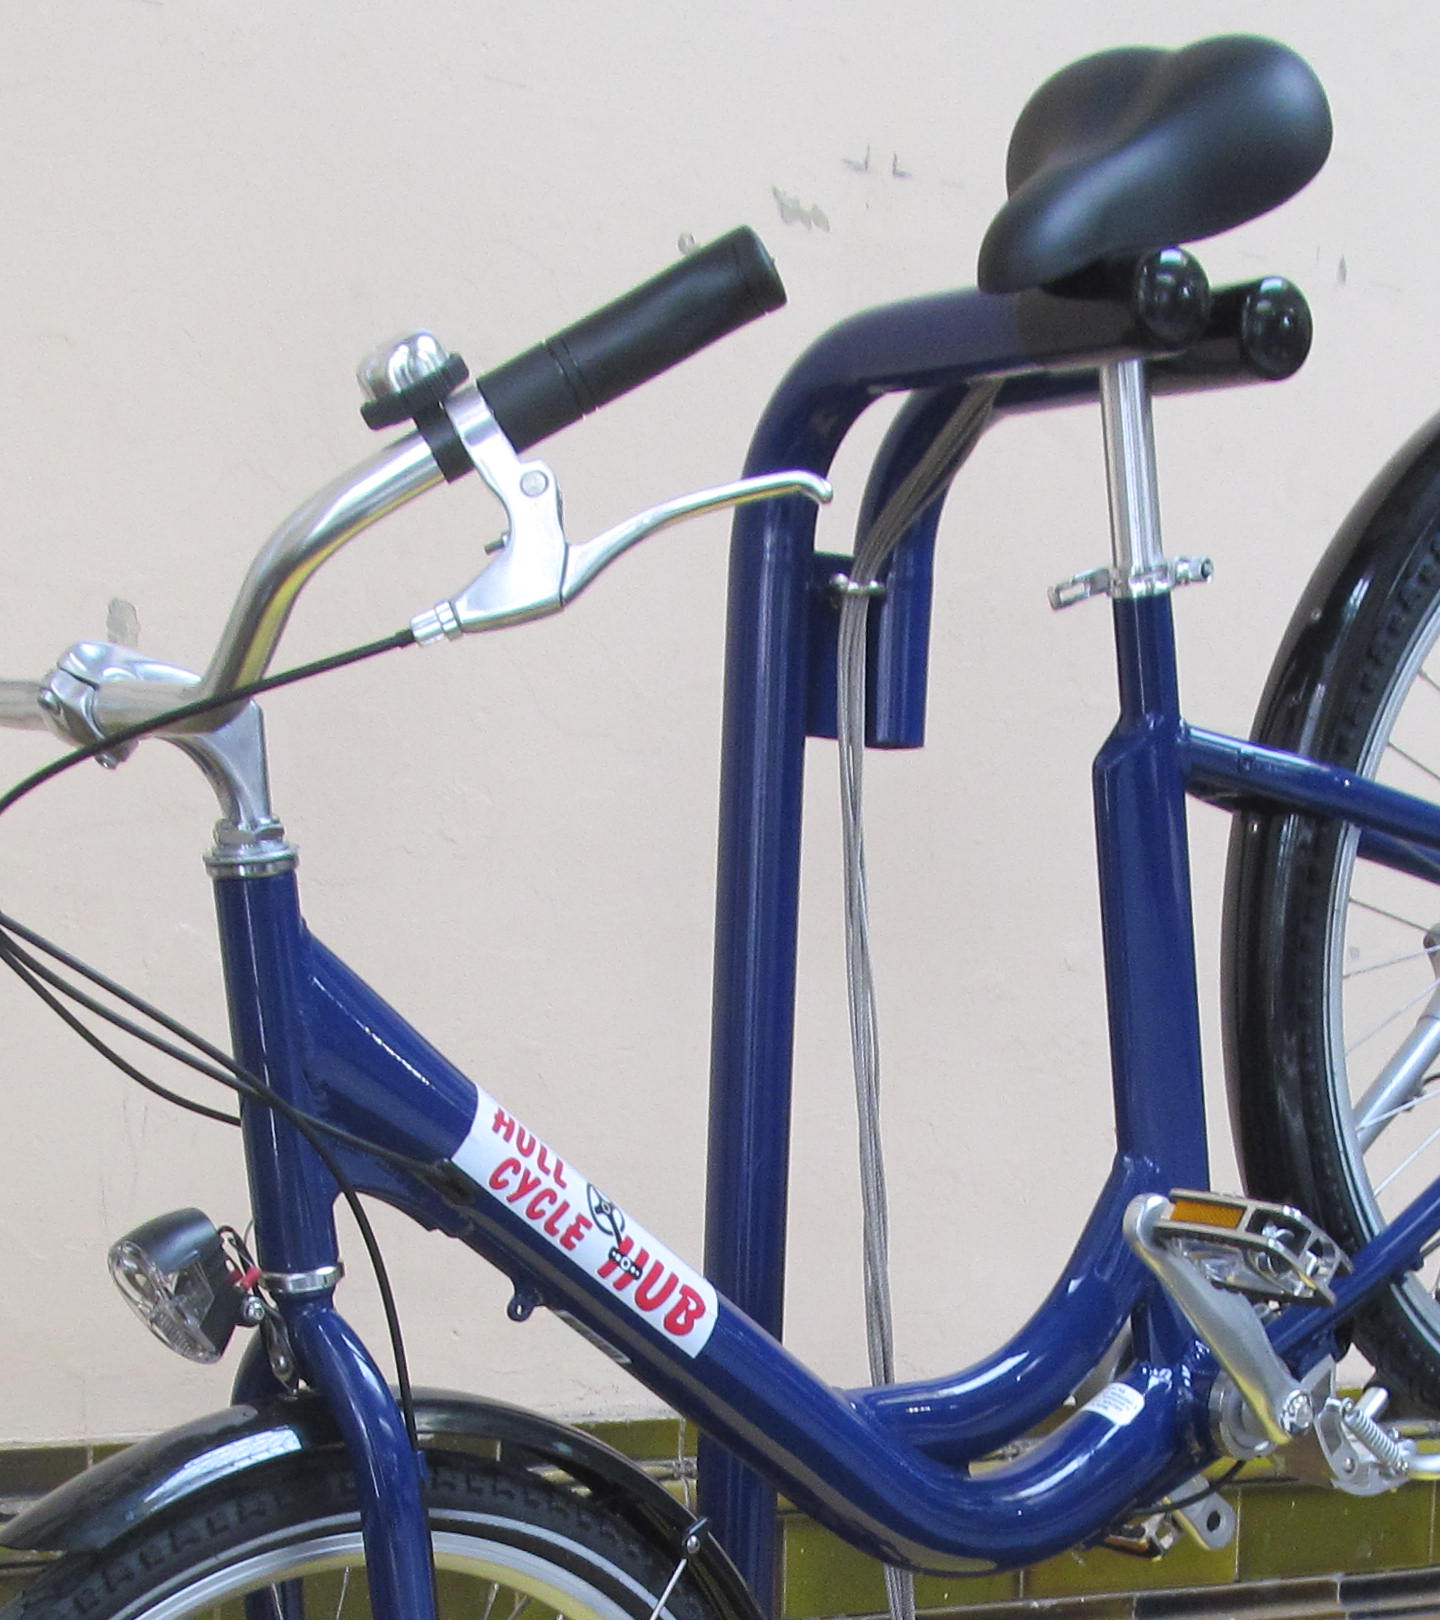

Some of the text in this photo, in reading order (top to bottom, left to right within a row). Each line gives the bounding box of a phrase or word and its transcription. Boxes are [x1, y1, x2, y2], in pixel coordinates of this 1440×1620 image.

[491, 1107, 568, 1190] HULL
[488, 1157, 707, 1337] CYCLE HUB
